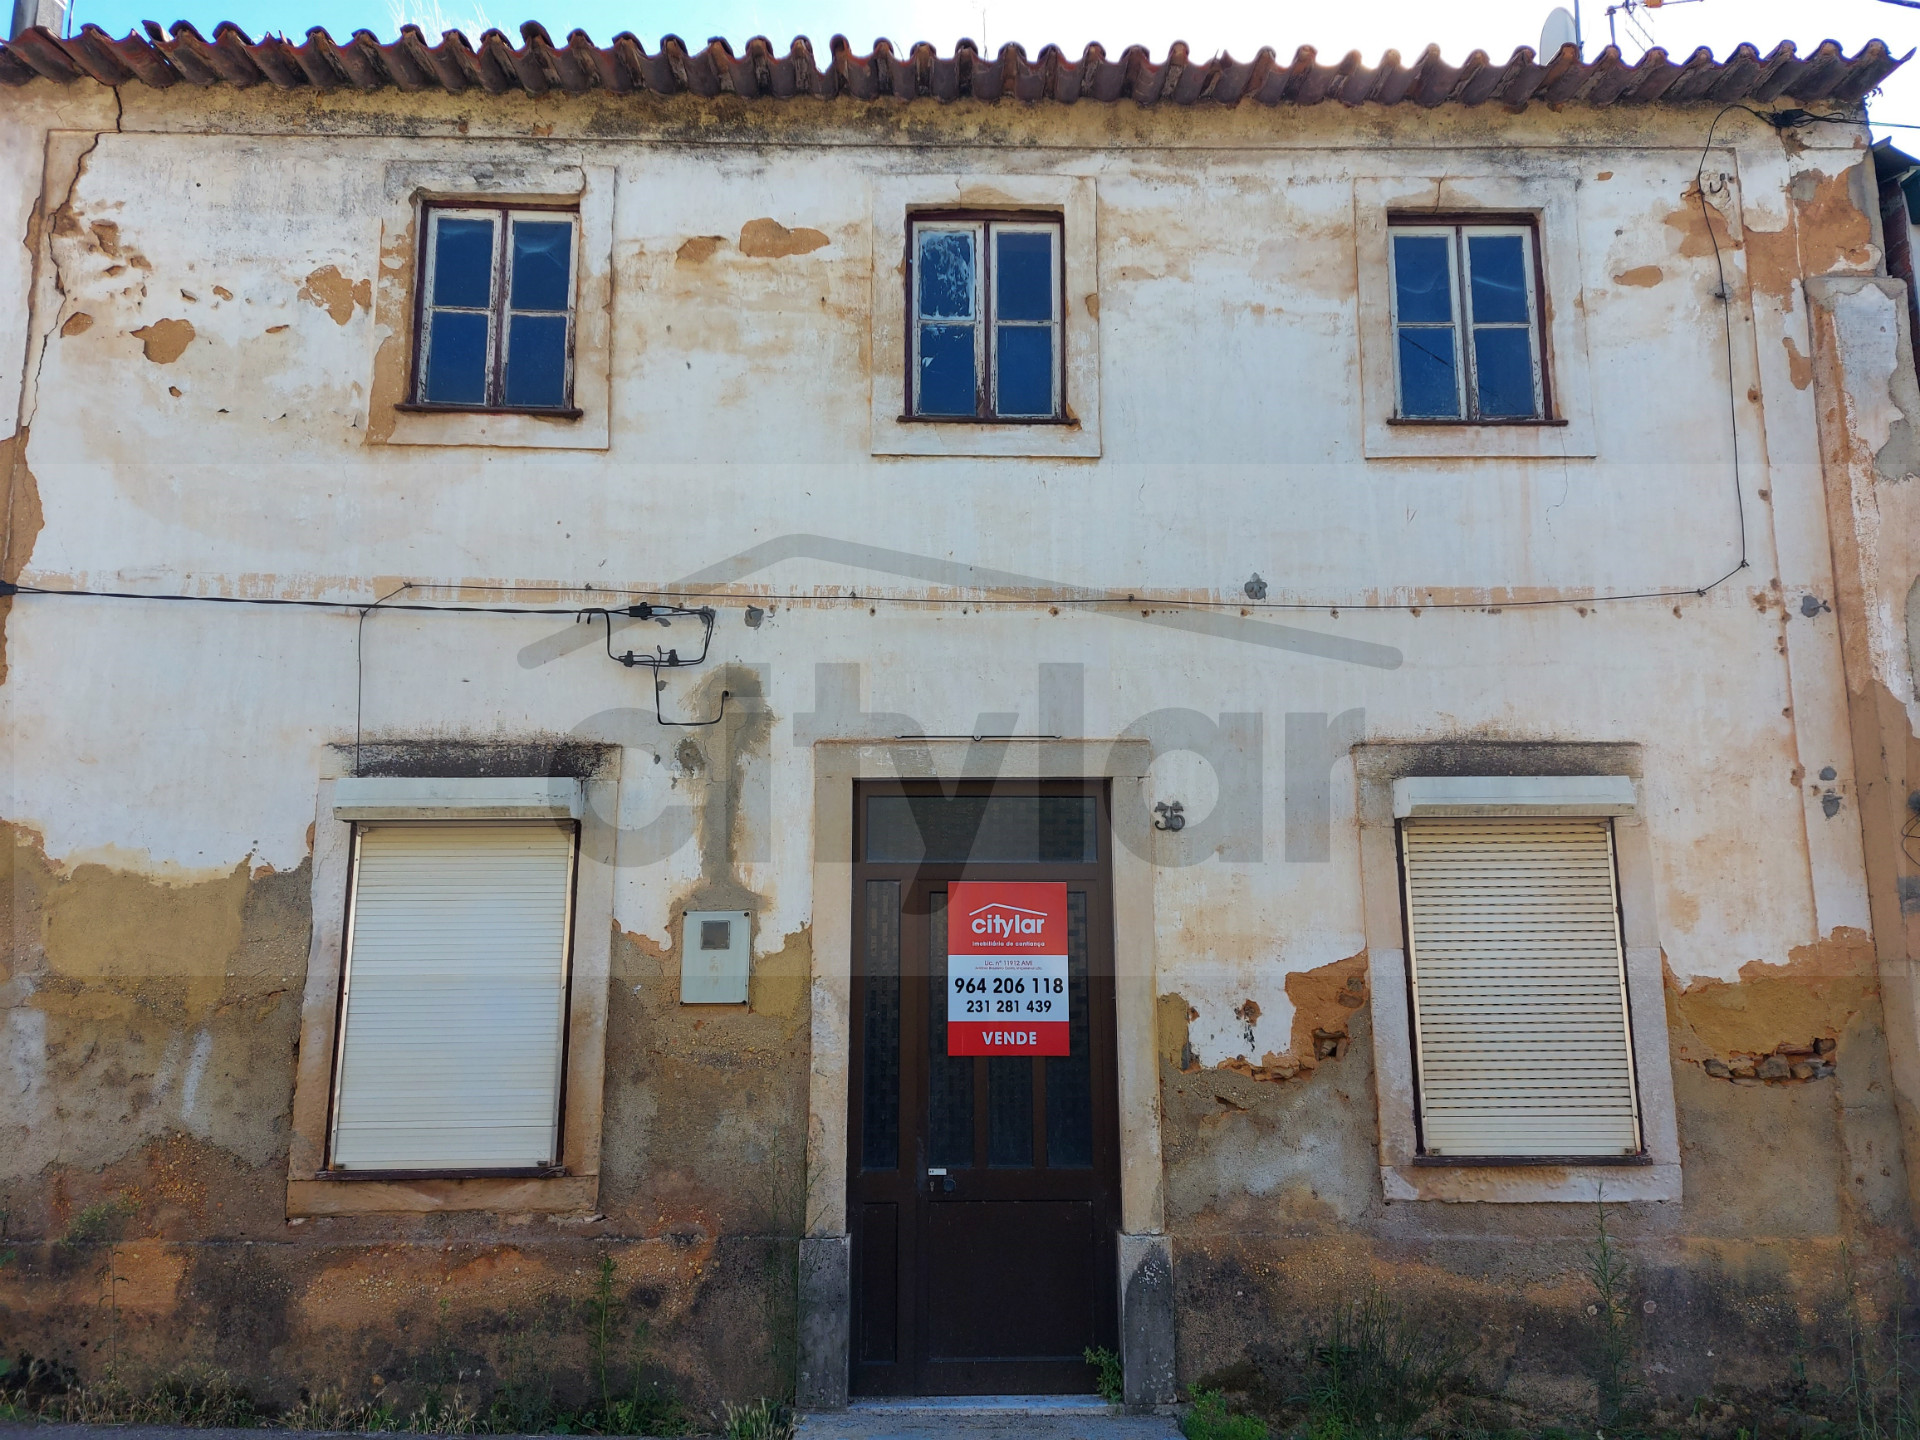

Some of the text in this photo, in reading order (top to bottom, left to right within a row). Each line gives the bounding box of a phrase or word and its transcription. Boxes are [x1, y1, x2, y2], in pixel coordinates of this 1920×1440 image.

[1154, 801, 1185, 832] 35
[971, 914, 1044, 938] citylar
[955, 978, 1063, 994] 964 206 118
[967, 1000, 1052, 1013] 231 281 439
[982, 1031, 1037, 1045] VENDE
